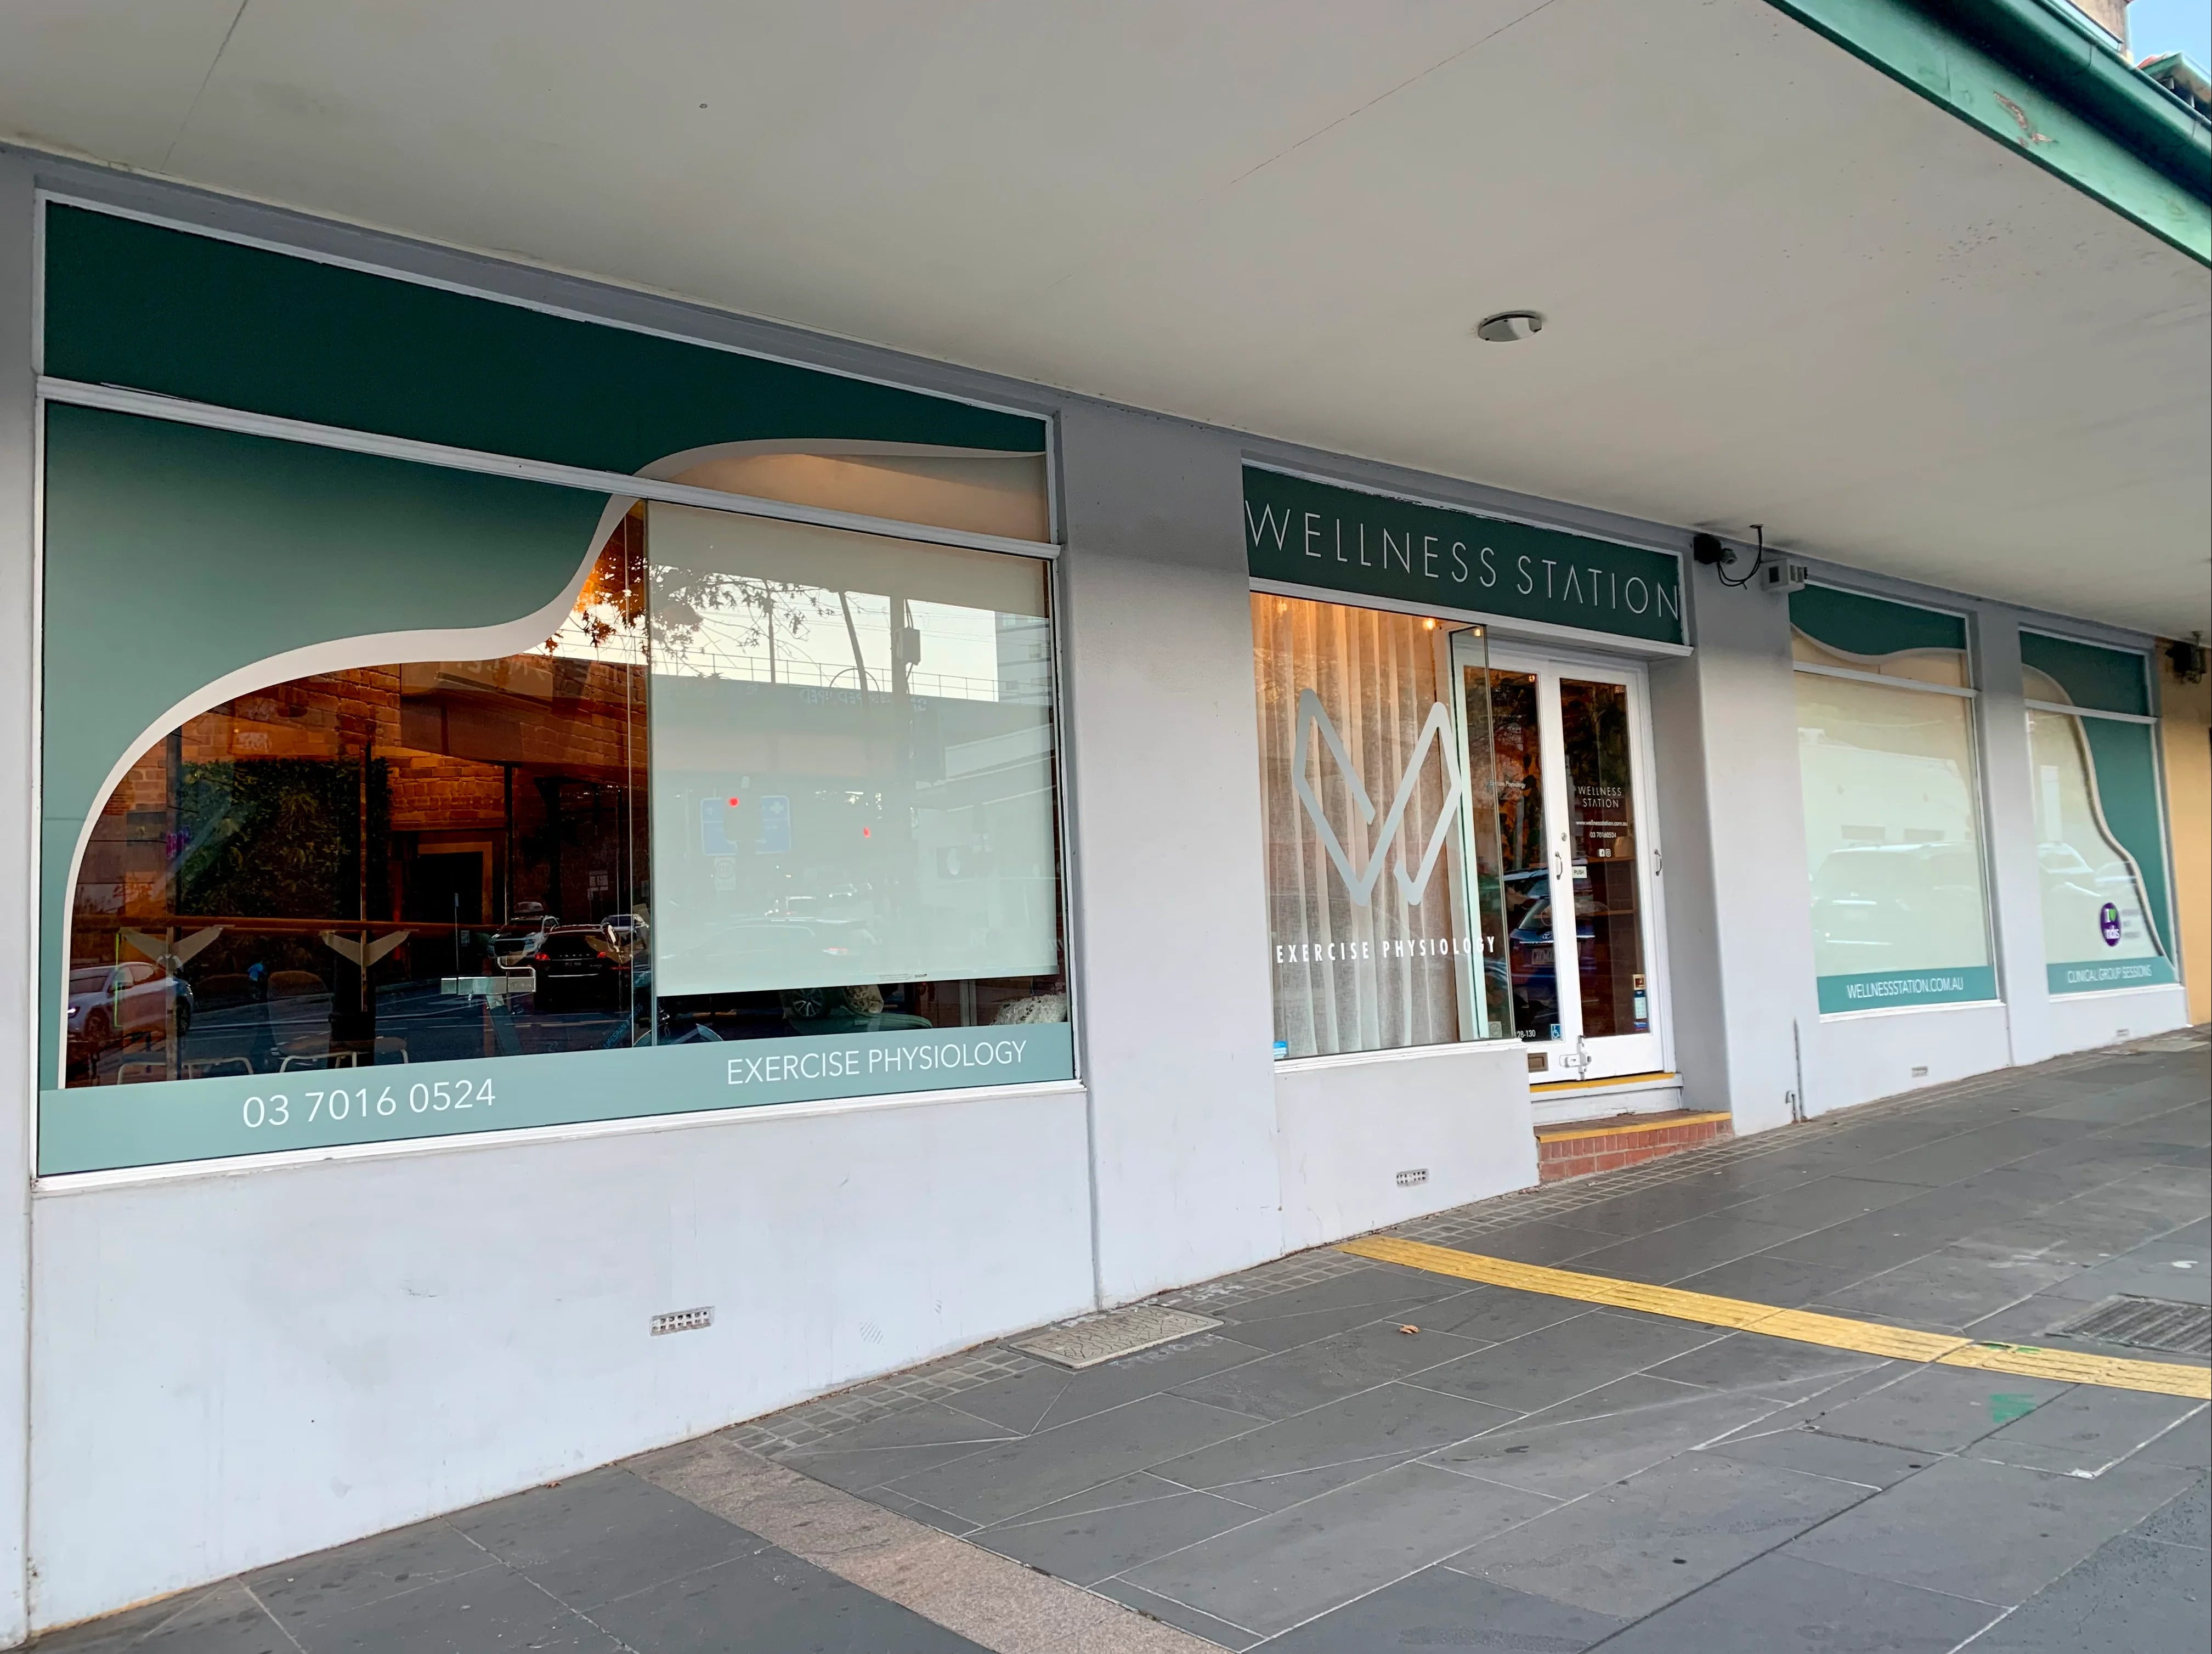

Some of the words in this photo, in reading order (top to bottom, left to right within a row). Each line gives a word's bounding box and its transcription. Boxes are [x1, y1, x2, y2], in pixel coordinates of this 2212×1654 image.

[1245, 500, 1496, 587] WELLNESS
[1517, 555, 1679, 620] STATION
[1578, 786, 1622, 796] WELLNESS
[1583, 798, 1619, 808] STATION
[1276, 941, 1370, 963] EXERCISE
[1383, 936, 1495, 958] PHYSIOLOGY
[2068, 969, 2098, 983] CLINICAL
[2099, 967, 2122, 980] GROUP
[2122, 965, 2152, 979] SESSIONS
[1846, 976, 1964, 998] WELLNESSSTATION.COM.AU
[1515, 1029, 1536, 1038] 28-130
[727, 1050, 860, 1085] EXERCISE
[869, 1040, 1027, 1073] PHYSIOLOGY
[243, 1094, 290, 1128] 03
[305, 1086, 397, 1122] 7016
[409, 1078, 496, 1113] 0524
